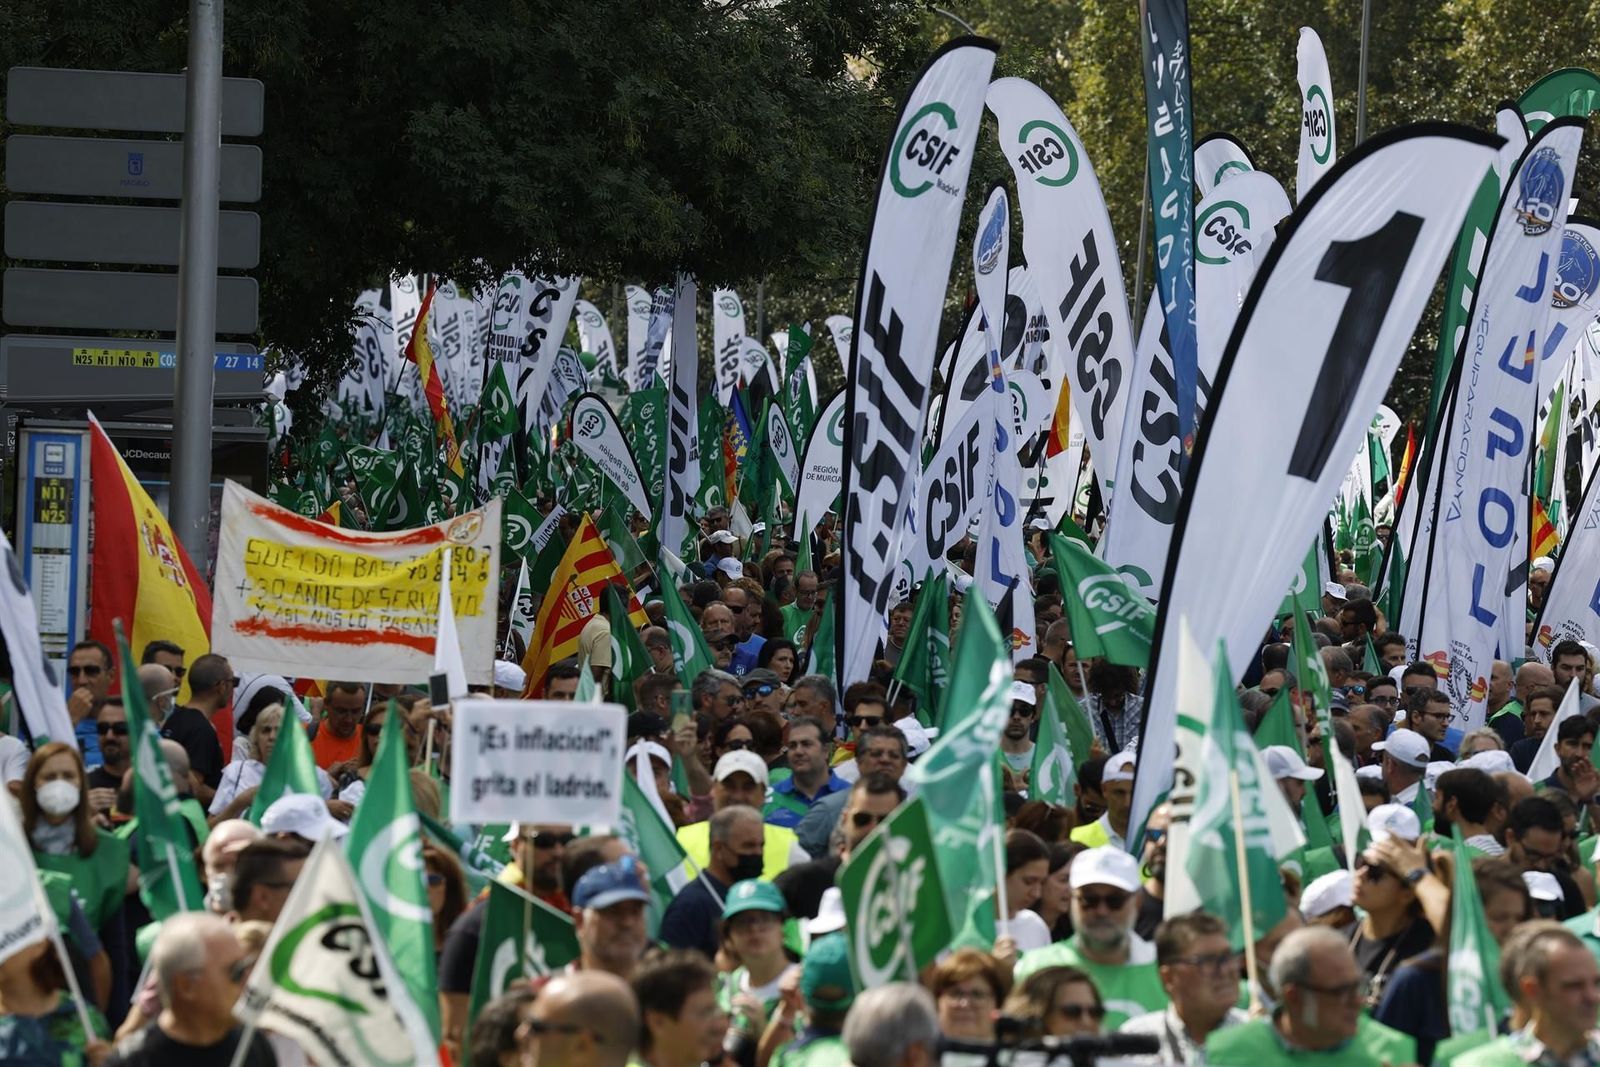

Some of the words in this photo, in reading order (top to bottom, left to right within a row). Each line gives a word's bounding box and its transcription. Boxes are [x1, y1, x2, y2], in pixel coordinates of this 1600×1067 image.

[905, 128, 960, 176] CSIF
[1204, 215, 1252, 256] CSIF
[75, 355, 93, 365] N25
[97, 355, 114, 365] N11
[119, 356, 136, 366] N10
[142, 357, 154, 367] N9
[225, 357, 239, 368] 27
[246, 357, 259, 368] 14
[1287, 210, 1426, 483] 1
[792, 407, 806, 456] CSI
[122, 449, 171, 459] JCDecaux
[812, 464, 839, 474] REGIÓN
[41, 486, 65, 500] N11
[815, 474, 842, 483] MURCIA
[926, 419, 980, 560] CSIF
[41, 510, 65, 523] N25
[246, 539, 341, 578] SUELDO
[236, 578, 286, 600] +30
[293, 578, 343, 610] AÑOS
[380, 587, 478, 617] SERVIIO
[1085, 587, 1149, 620] CSIF
[256, 603, 266, 618] Y
[311, 609, 343, 628] NOS
[347, 613, 368, 629] LO
[471, 771, 516, 802] grita
[523, 772, 540, 796] el
[545, 771, 611, 798] ladrón.
